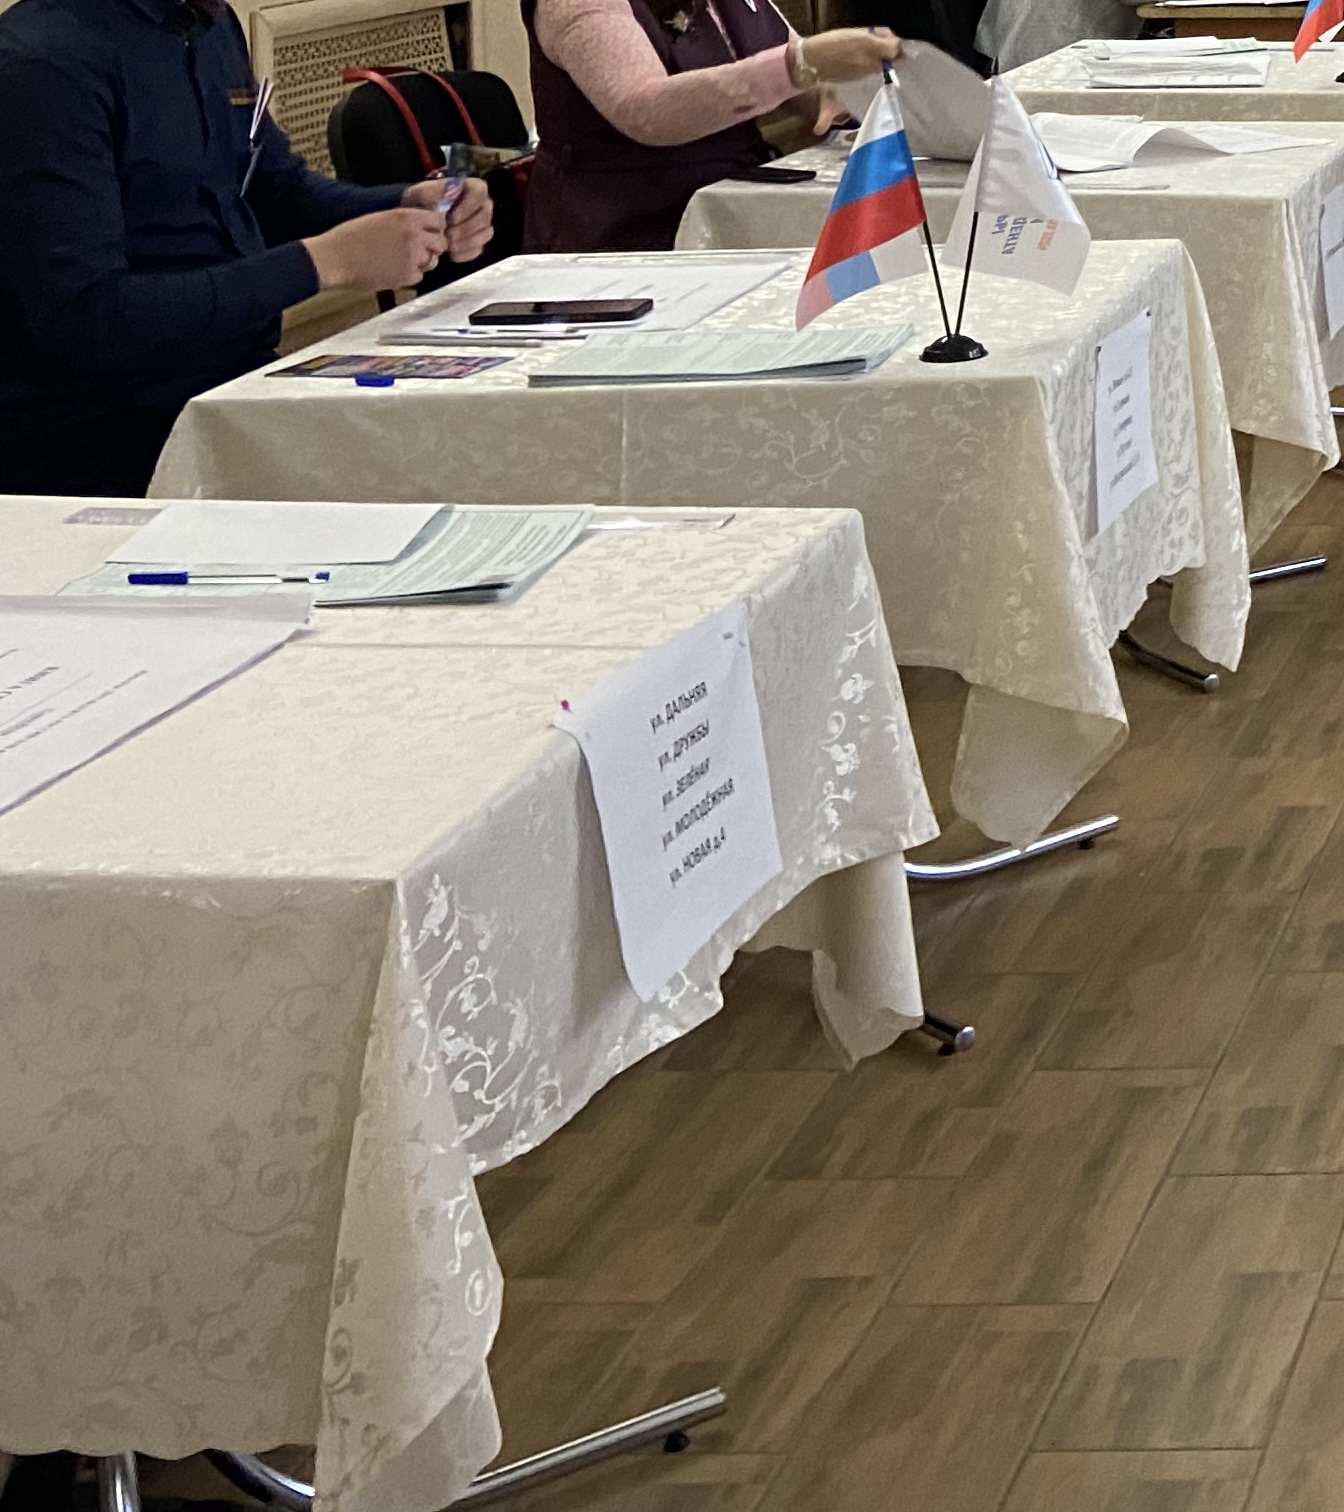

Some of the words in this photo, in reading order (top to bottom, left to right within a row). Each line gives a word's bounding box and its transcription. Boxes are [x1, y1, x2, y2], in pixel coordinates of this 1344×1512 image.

[665, 681, 707, 724] ДАЛЬНЯЯ
[673, 719, 709, 763] ДРУЖБЫ
[681, 837, 712, 873] НОВАЯ
